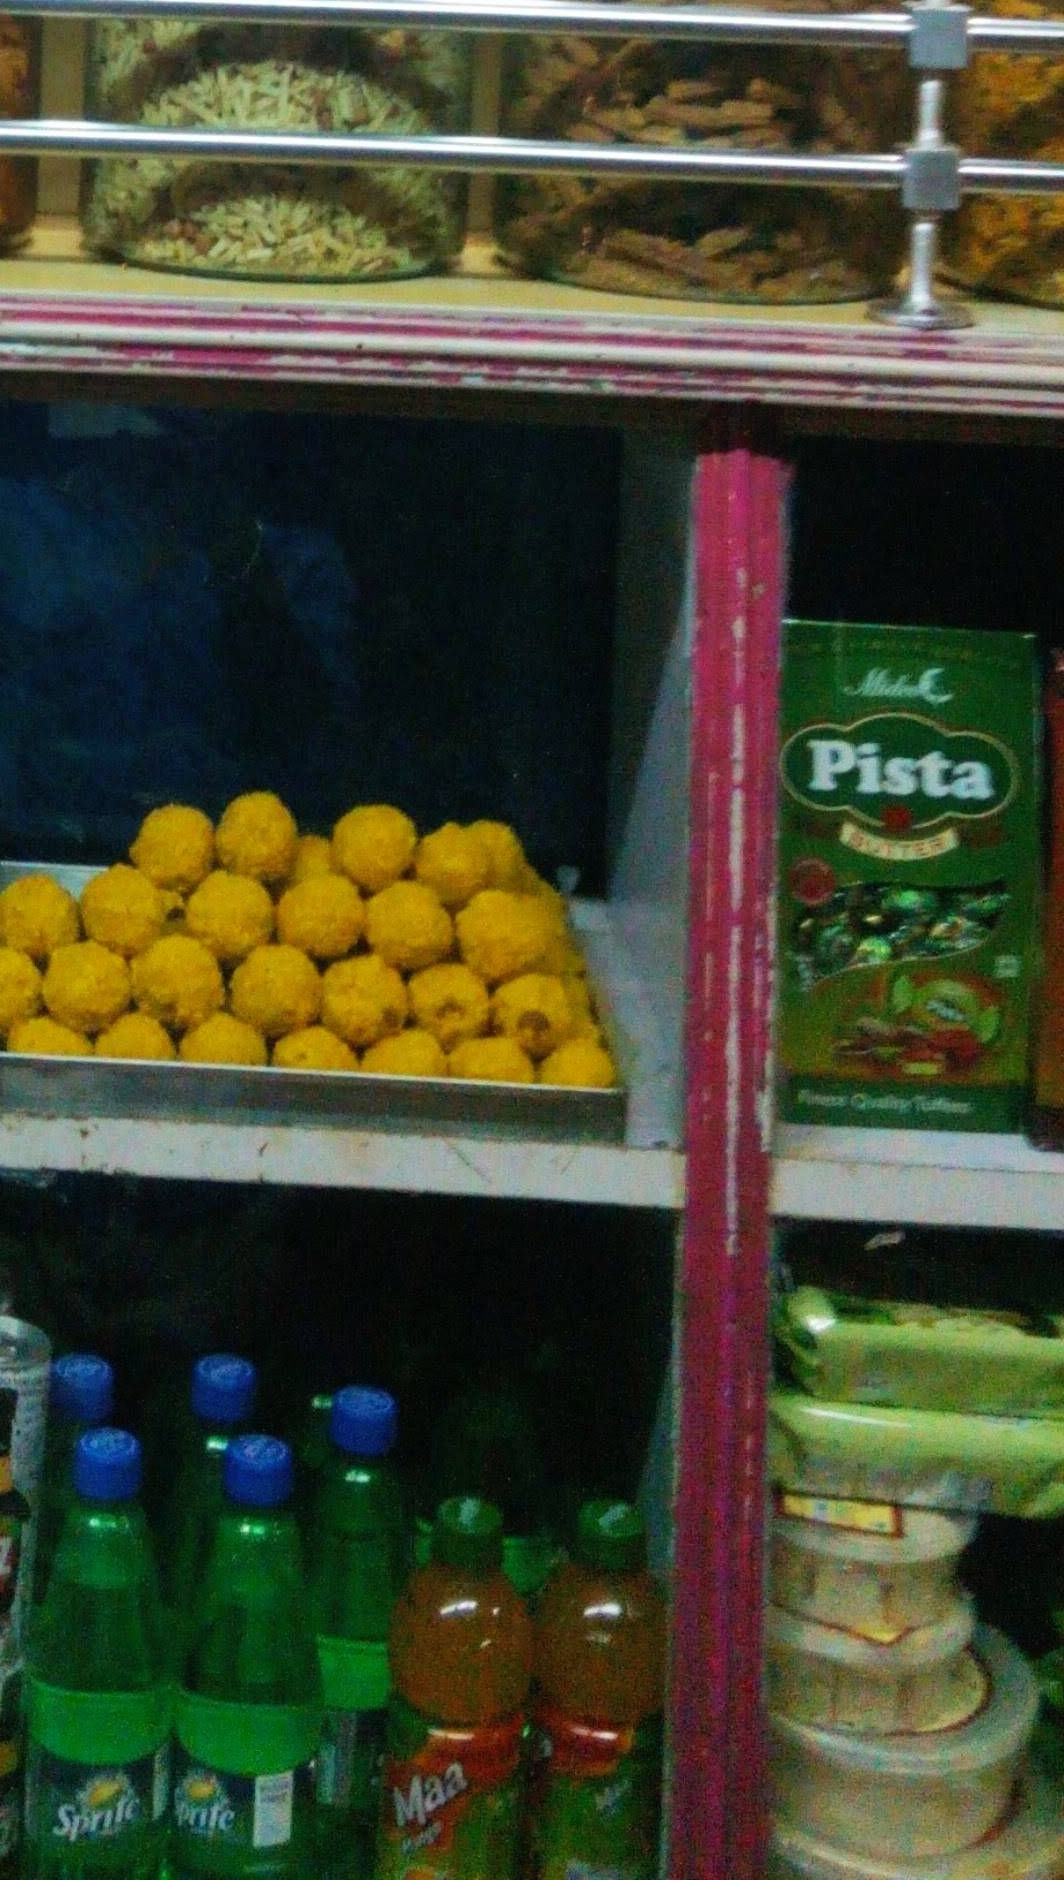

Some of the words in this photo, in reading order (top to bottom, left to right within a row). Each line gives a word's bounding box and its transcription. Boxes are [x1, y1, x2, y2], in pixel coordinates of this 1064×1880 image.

[807, 739, 996, 801] Pista
[53, 1792, 140, 1843] Sprite
[392, 1760, 468, 1826] Maa
